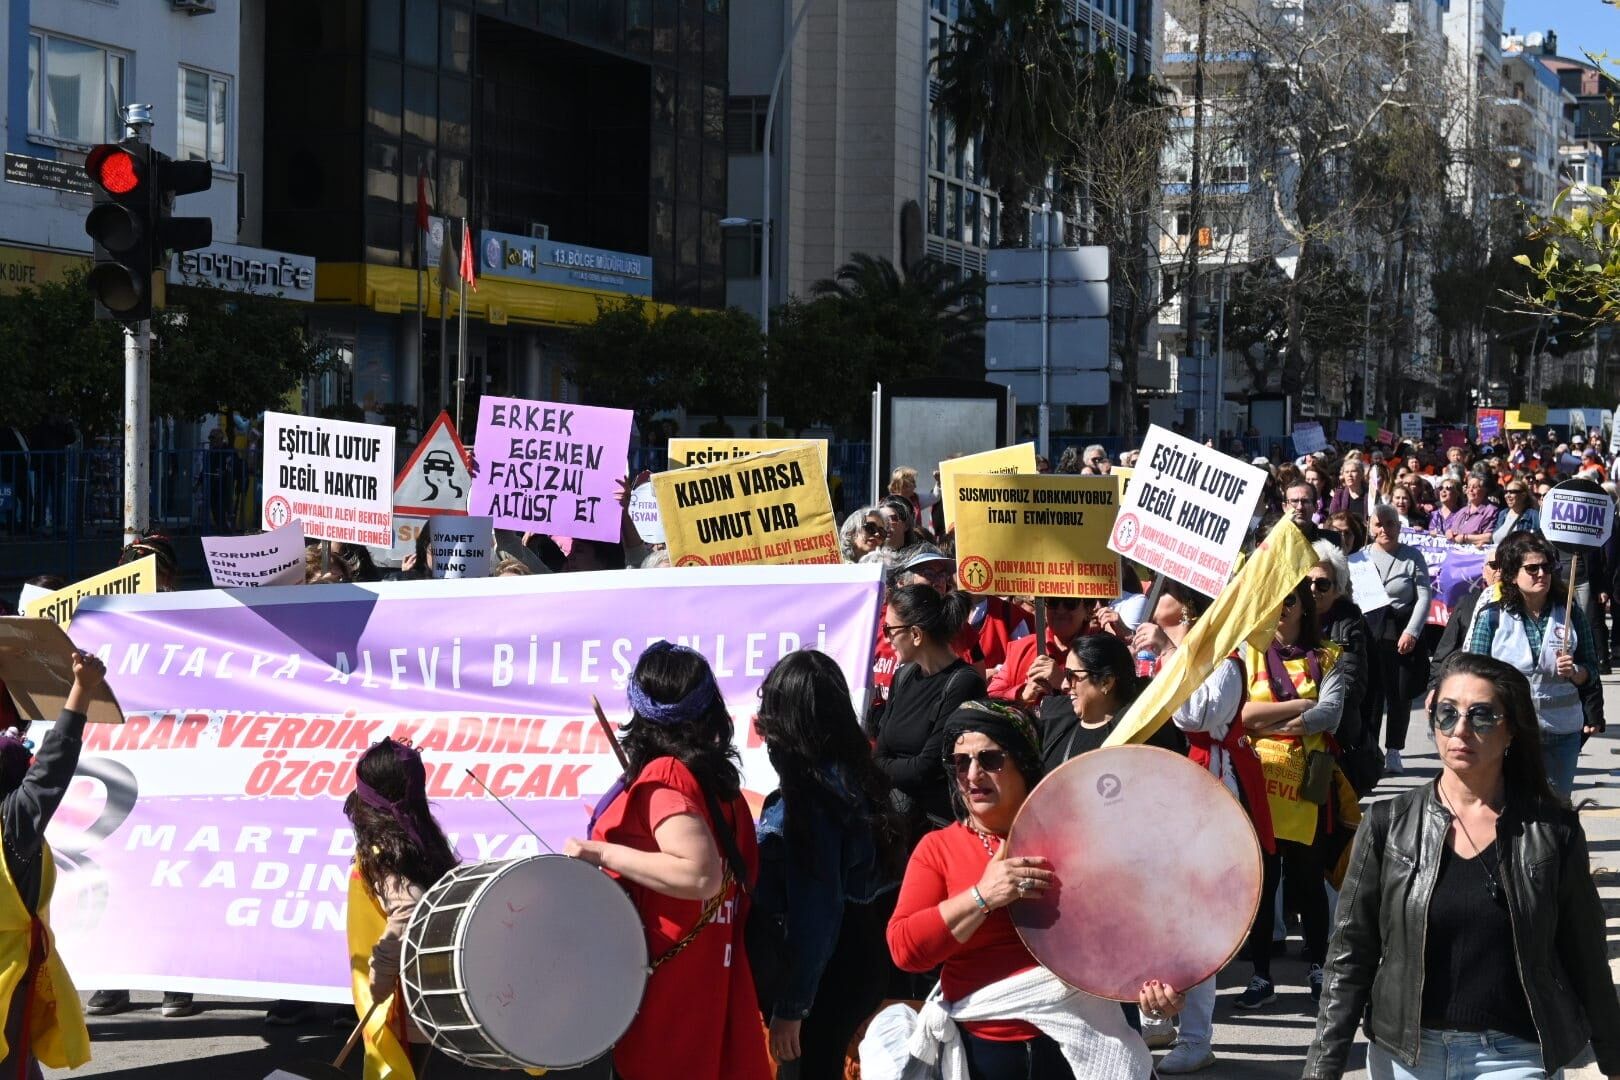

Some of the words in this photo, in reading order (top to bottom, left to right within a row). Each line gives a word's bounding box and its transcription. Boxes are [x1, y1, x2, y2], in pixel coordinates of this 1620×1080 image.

[490, 404, 574, 437] ERKEK
[278, 425, 330, 460] EŞİTLİK
[336, 434, 381, 462] LUTUF
[508, 438, 603, 470] EGEMEN
[324, 471, 378, 500] HAKTIR
[674, 473, 734, 508] KADIN
[737, 461, 805, 497] VARSA
[1150, 443, 1203, 487] EŞİTLİK
[1199, 465, 1248, 505] LUTUF
[487, 493, 558, 523] ALTÜST
[574, 497, 601, 523] ET
[959, 487, 1030, 503] SUSMUYORUZ
[1032, 489, 1113, 505] KORKMUYORUZ
[292, 501, 333, 519] KONYAALTI
[335, 506, 357, 523] ALEVİ
[358, 511, 390, 530] BEKTAŞİ
[697, 510, 753, 544] UMUT
[757, 502, 799, 533] VAR
[988, 507, 1017, 524] İTAAT
[1023, 508, 1083, 526] ETMİYORUZ
[1176, 500, 1231, 546] HAKTIR
[1551, 501, 1606, 527] KADIN
[326, 525, 356, 541] CEMEVİ
[358, 529, 391, 545] DERNEĞİ
[709, 547, 762, 566] KONYAALTI
[764, 539, 792, 558] ALEVİ
[795, 531, 836, 552] BEKTAŞİ
[1140, 524, 1177, 552] KONYAALTI
[1176, 542, 1200, 561] ALEVİ
[209, 547, 279, 559] ZORUNLU
[211, 560, 237, 568] DİN
[213, 558, 300, 578] DERSLERİNE
[216, 576, 260, 587] HAYIR
[994, 560, 1045, 575] KONYAALTI
[1048, 560, 1074, 576] ALEVİ
[1077, 562, 1117, 582] BEKTAŞİ
[1133, 543, 1164, 569] KÜLTÜRÜ
[1163, 558, 1192, 583] CEMEVİ
[1190, 572, 1224, 597] DERNEĞİ
[994, 578, 1035, 593] KÜLTÜRÜ
[1038, 580, 1075, 594] CEMEVİ
[1077, 581, 1119, 597] DERNEĞİ
[325, 637, 462, 690] ALEVİ
[217, 709, 383, 750] VERDİK
[125, 824, 318, 856] MART
